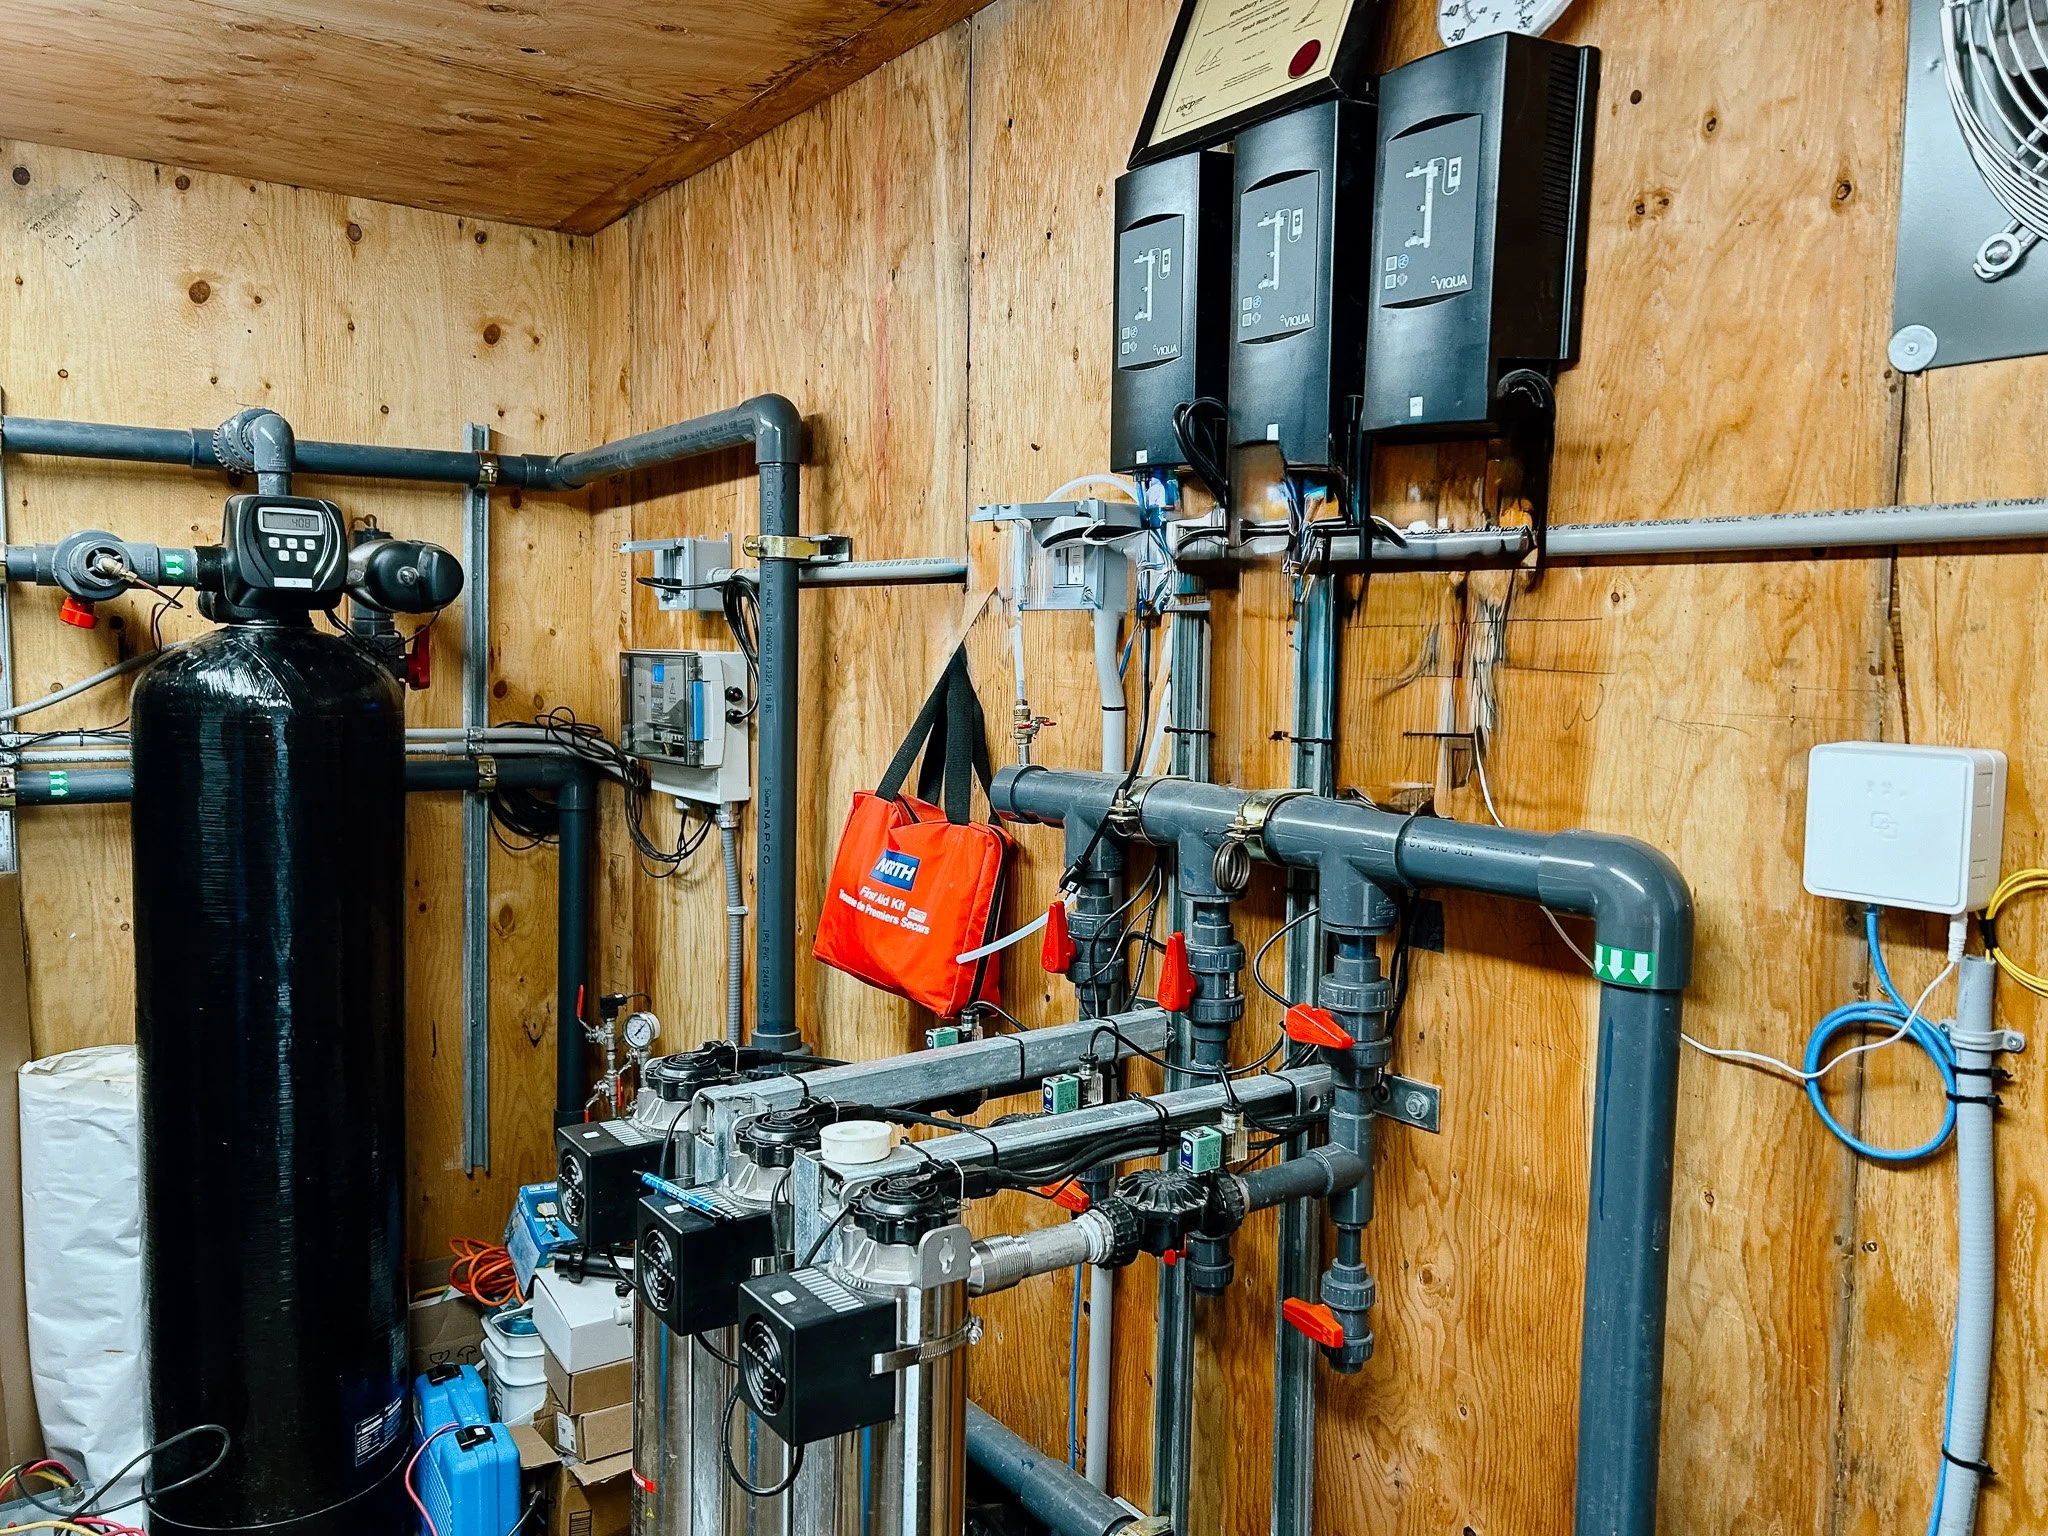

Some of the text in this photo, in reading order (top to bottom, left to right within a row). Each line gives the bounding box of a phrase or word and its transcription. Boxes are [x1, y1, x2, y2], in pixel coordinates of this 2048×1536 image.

[1441, 4, 1460, 17] -40
[1447, 28, 1466, 42] -50
[1435, 273, 1469, 290] VIQUA
[1283, 312, 1311, 328] VIQUA
[1155, 343, 1179, 356] VIQUA
[291, 517, 311, 529] 408
[765, 500, 774, 534] POTABLE
[765, 589, 773, 608] MADE
[765, 613, 773, 627] IN
[765, 627, 773, 655] CANADA
[764, 665, 773, 688] 23221
[763, 809, 771, 865] NAPCO
[859, 885, 879, 902] First
[874, 890, 890, 907] Aid
[890, 895, 907, 912] Kit
[857, 899, 866, 912] de
[865, 903, 900, 925] Premiers
[762, 929, 770, 943] IPS
